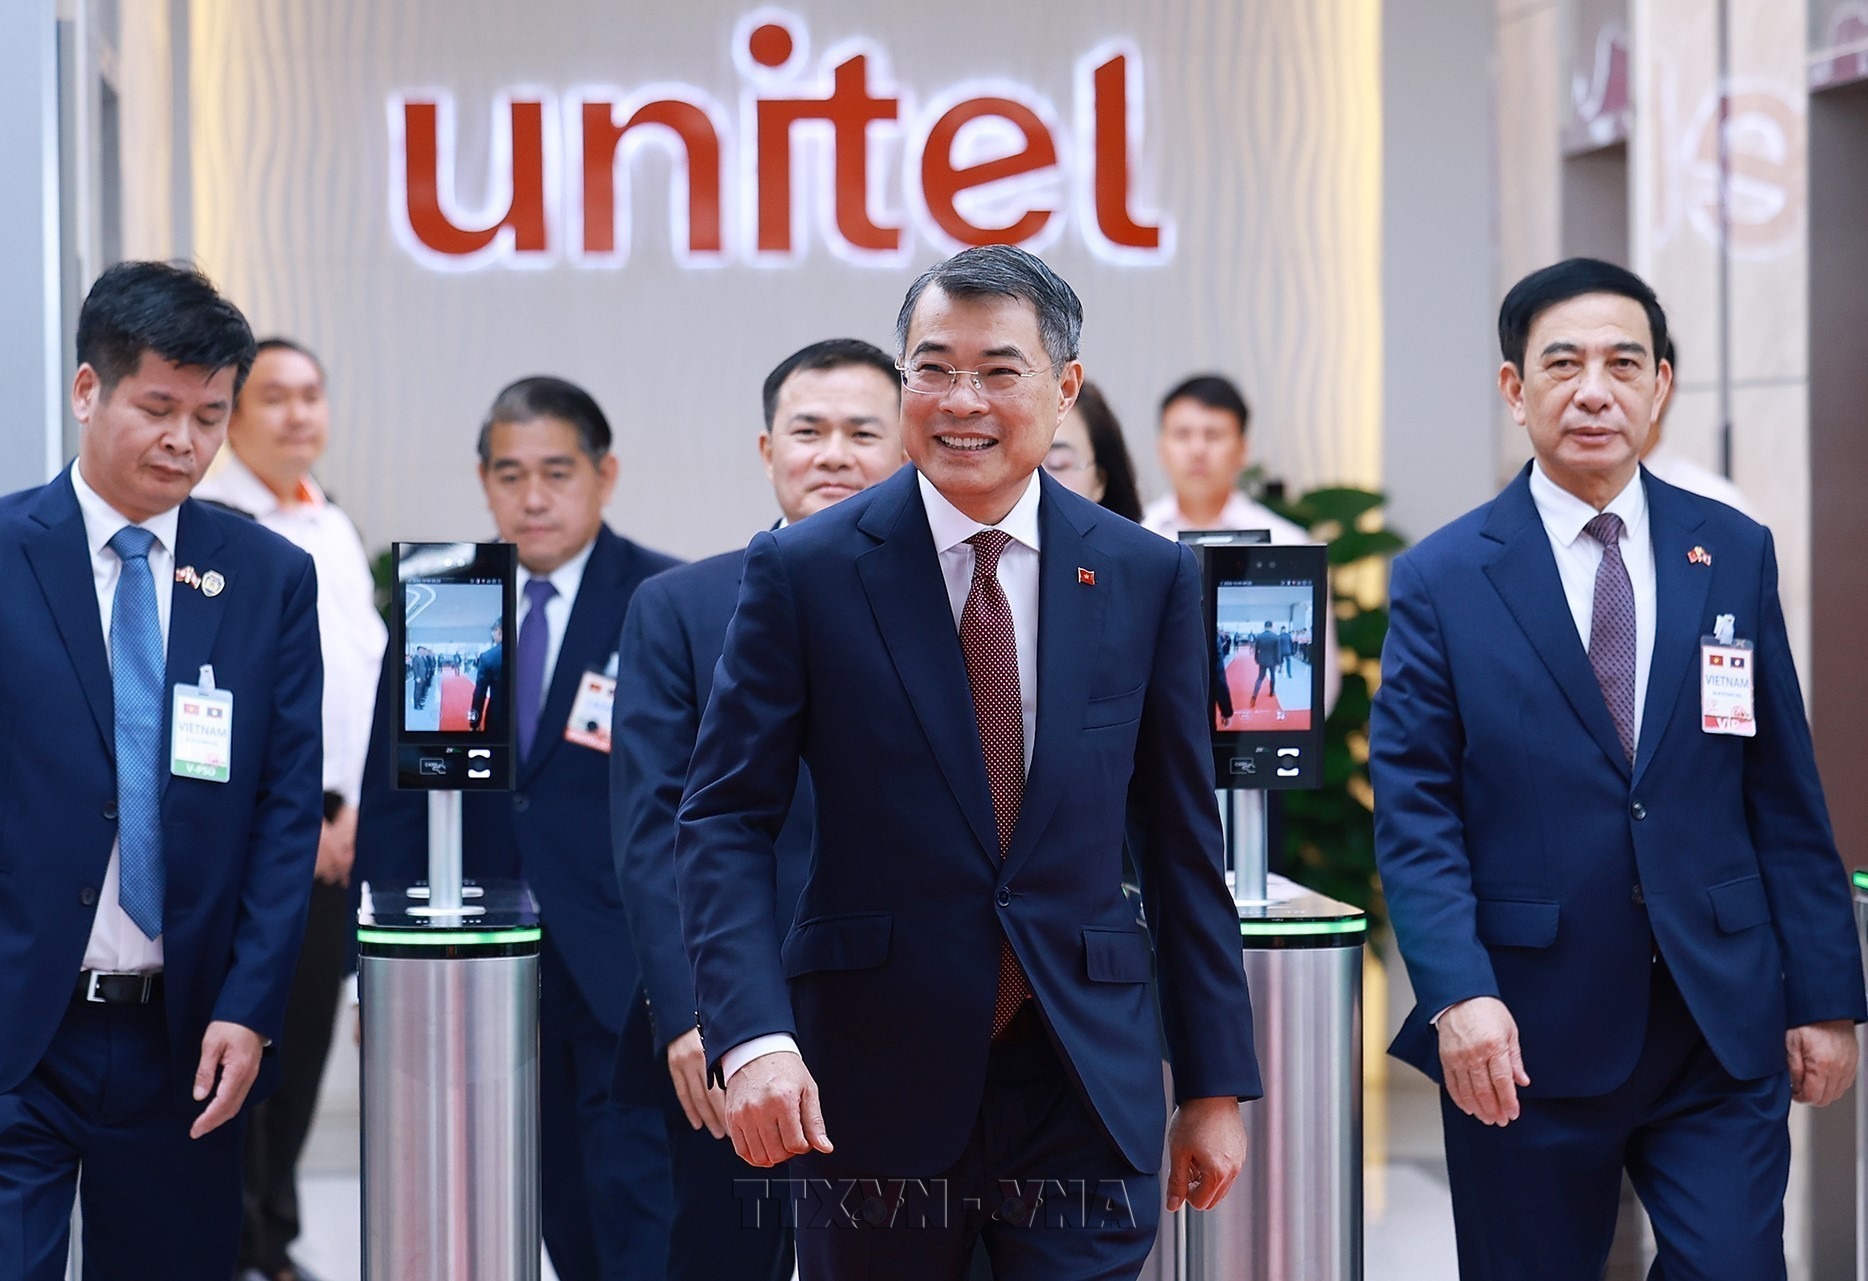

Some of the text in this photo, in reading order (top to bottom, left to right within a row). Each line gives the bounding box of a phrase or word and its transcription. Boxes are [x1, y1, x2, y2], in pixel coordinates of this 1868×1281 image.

[404, 25, 1160, 255] unitel
[1705, 675, 1749, 689] VIETNAM
[178, 722, 227, 738] VIETNAM
[1716, 717, 1741, 730] VIP
